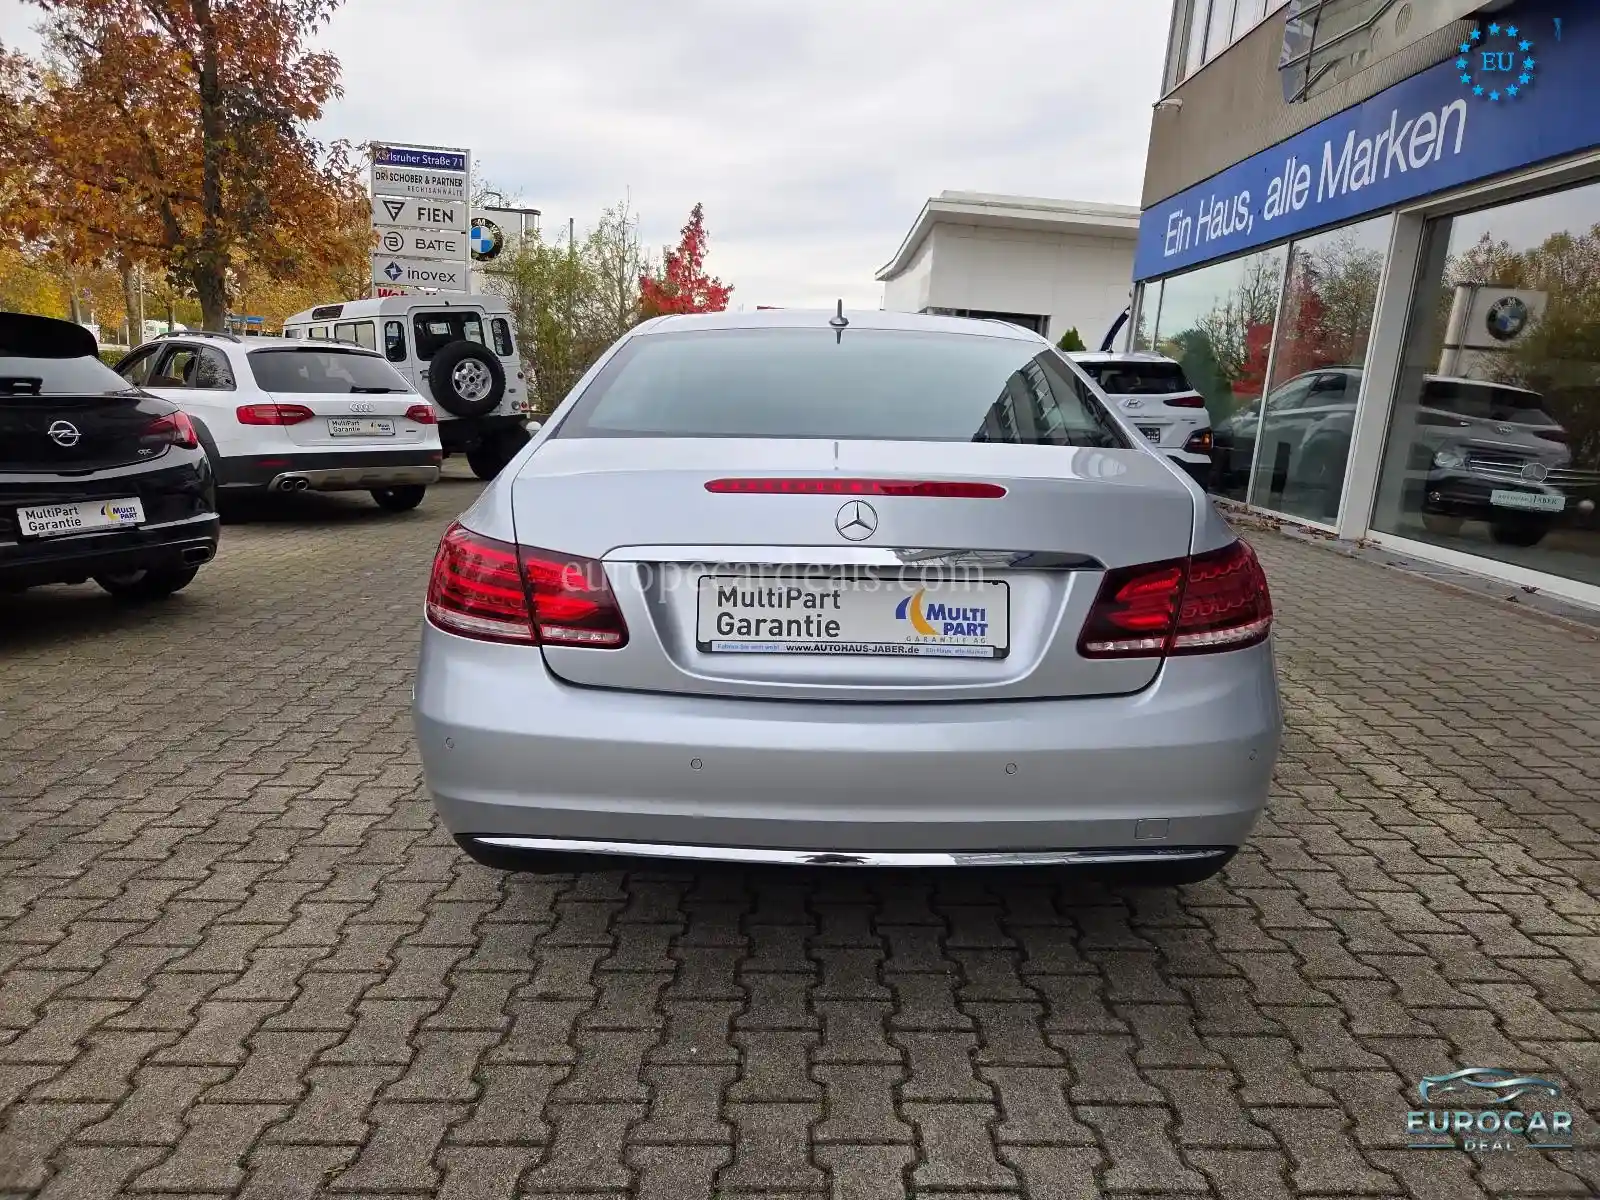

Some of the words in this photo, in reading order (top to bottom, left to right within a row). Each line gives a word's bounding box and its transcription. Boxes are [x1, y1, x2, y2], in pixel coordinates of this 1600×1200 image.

[422, 154, 450, 166] Straße
[452, 157, 463, 167] 71
[389, 172, 423, 184] SCHOBER
[424, 175, 430, 185] &
[432, 176, 463, 187] PARTNER
[1164, 208, 1192, 257] Ein
[1195, 189, 1255, 247] Haus,
[1263, 156, 1311, 221] alle
[1316, 98, 1468, 204] Marken
[417, 207, 454, 223] FIEN
[415, 238, 456, 252] BATE
[407, 266, 457, 283] inovex
[25, 506, 80, 521] MultiPart
[120, 512, 137, 520] PART
[28, 517, 82, 532] Garantie
[717, 585, 841, 610] MultiPart
[926, 604, 986, 622] MULTI
[716, 611, 841, 638] Garantie
[943, 622, 988, 636] PART
[906, 636, 967, 644] GARANTIE
[786, 643, 920, 655] www.AUTOHAUS-JABER.de
